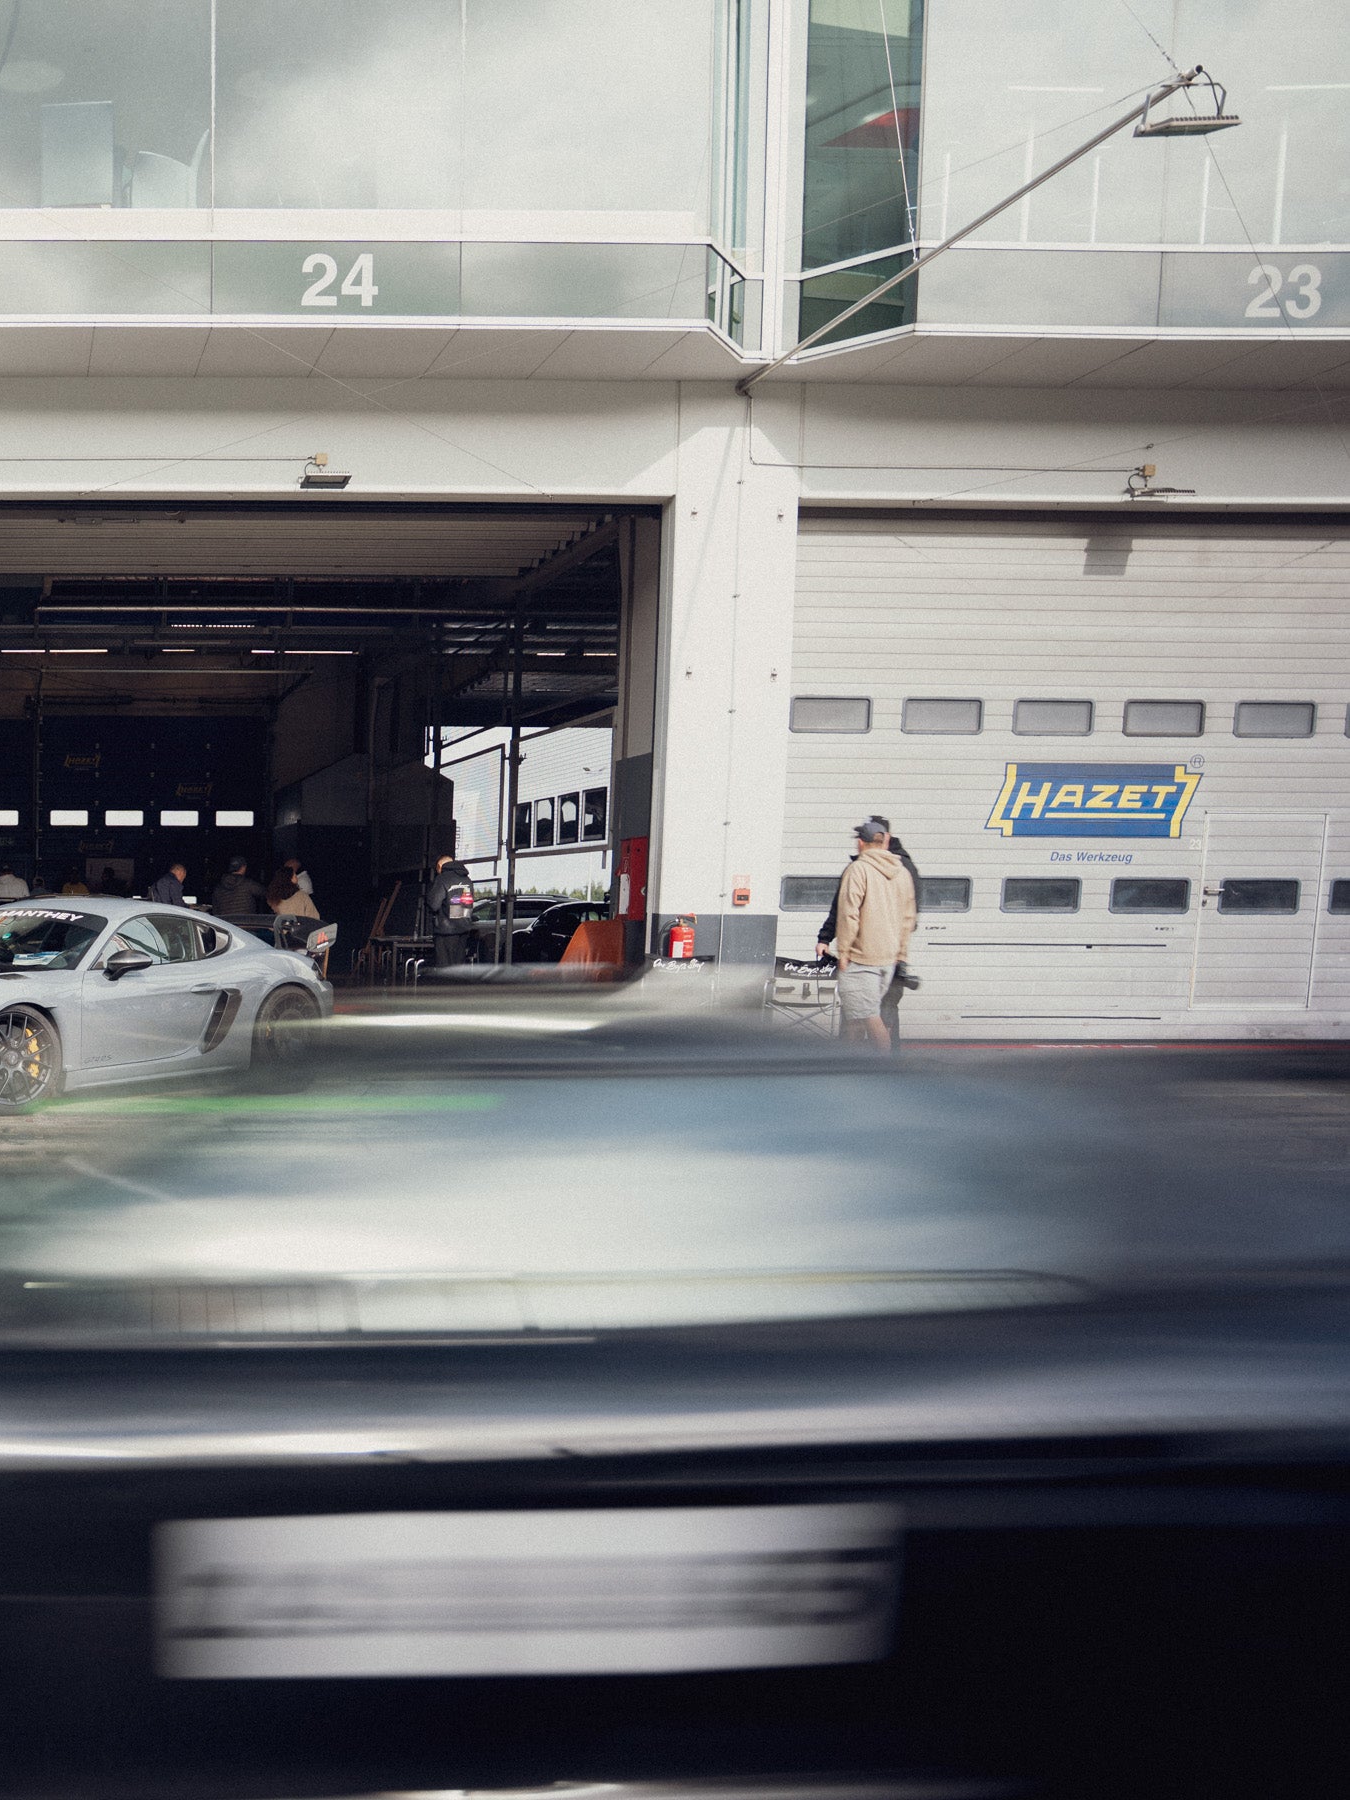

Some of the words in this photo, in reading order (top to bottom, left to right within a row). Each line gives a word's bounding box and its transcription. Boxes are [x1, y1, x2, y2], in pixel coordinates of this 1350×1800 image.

[301, 253, 379, 307] 24
[1245, 264, 1322, 319] 23
[1010, 782, 1178, 818] HAZET
[1050, 851, 1072, 862] Das
[1076, 851, 1133, 864] Werkzeug
[1189, 838, 1202, 849] 23
